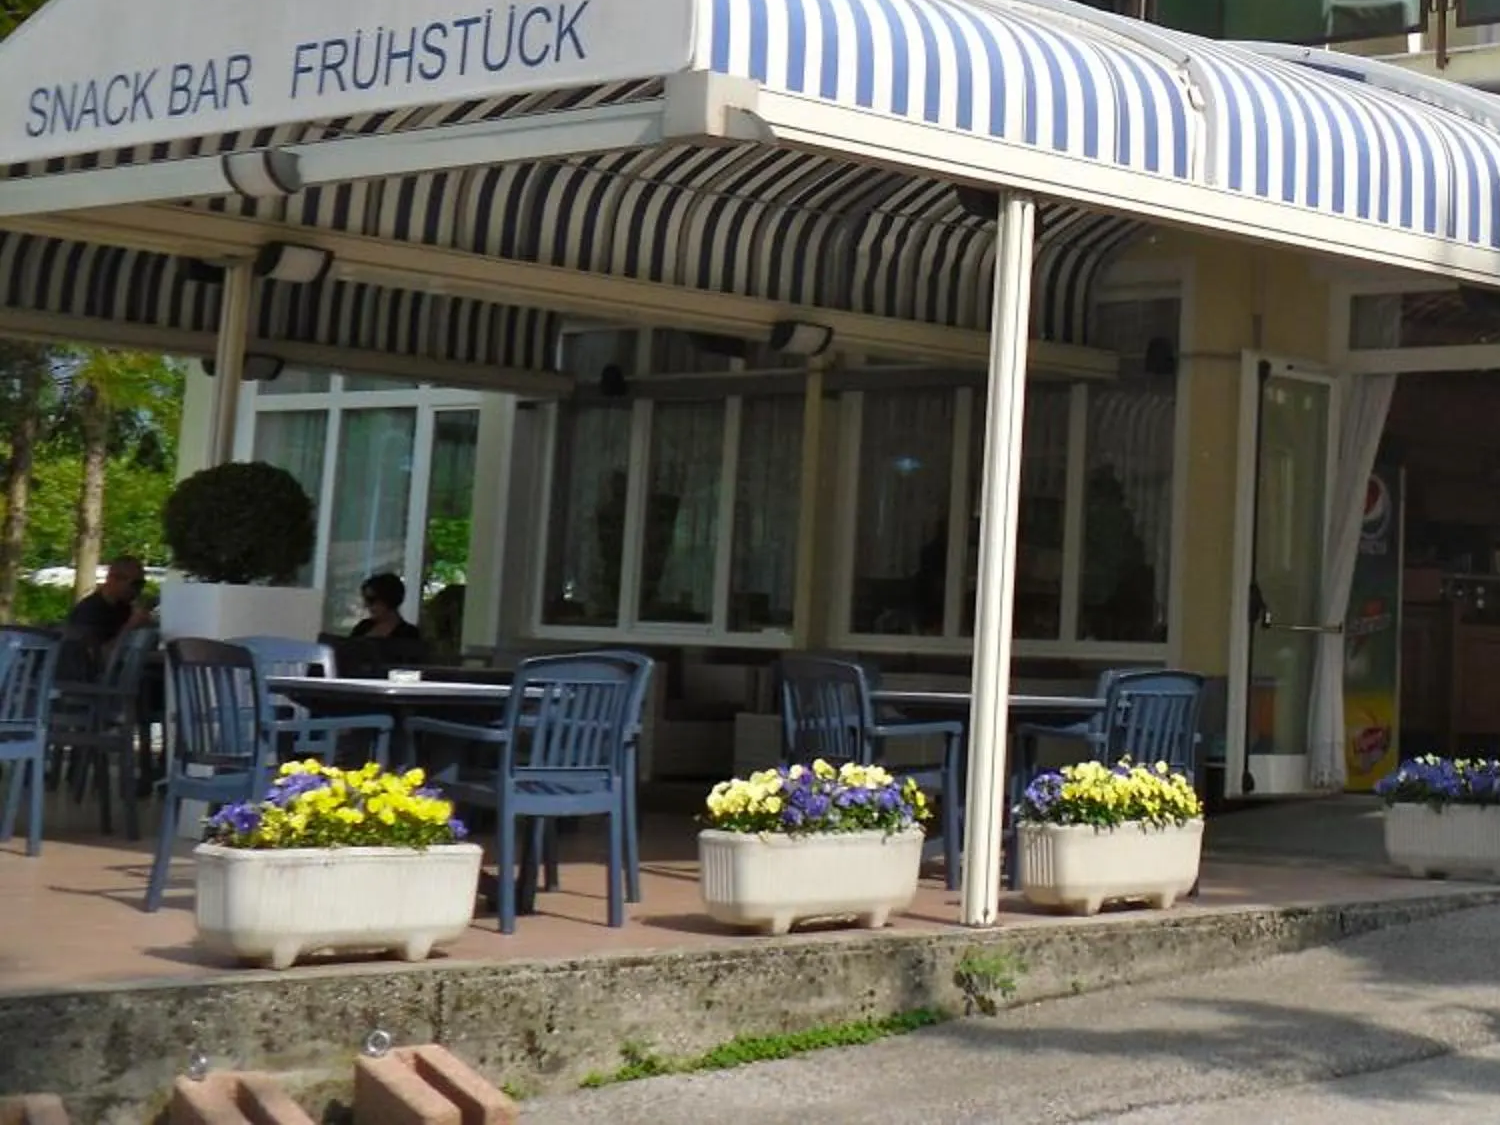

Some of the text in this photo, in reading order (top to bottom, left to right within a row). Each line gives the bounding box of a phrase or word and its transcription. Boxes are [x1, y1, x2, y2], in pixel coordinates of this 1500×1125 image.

[25, 0, 591, 138] SNACK BAR FRÜHSTÜCK
